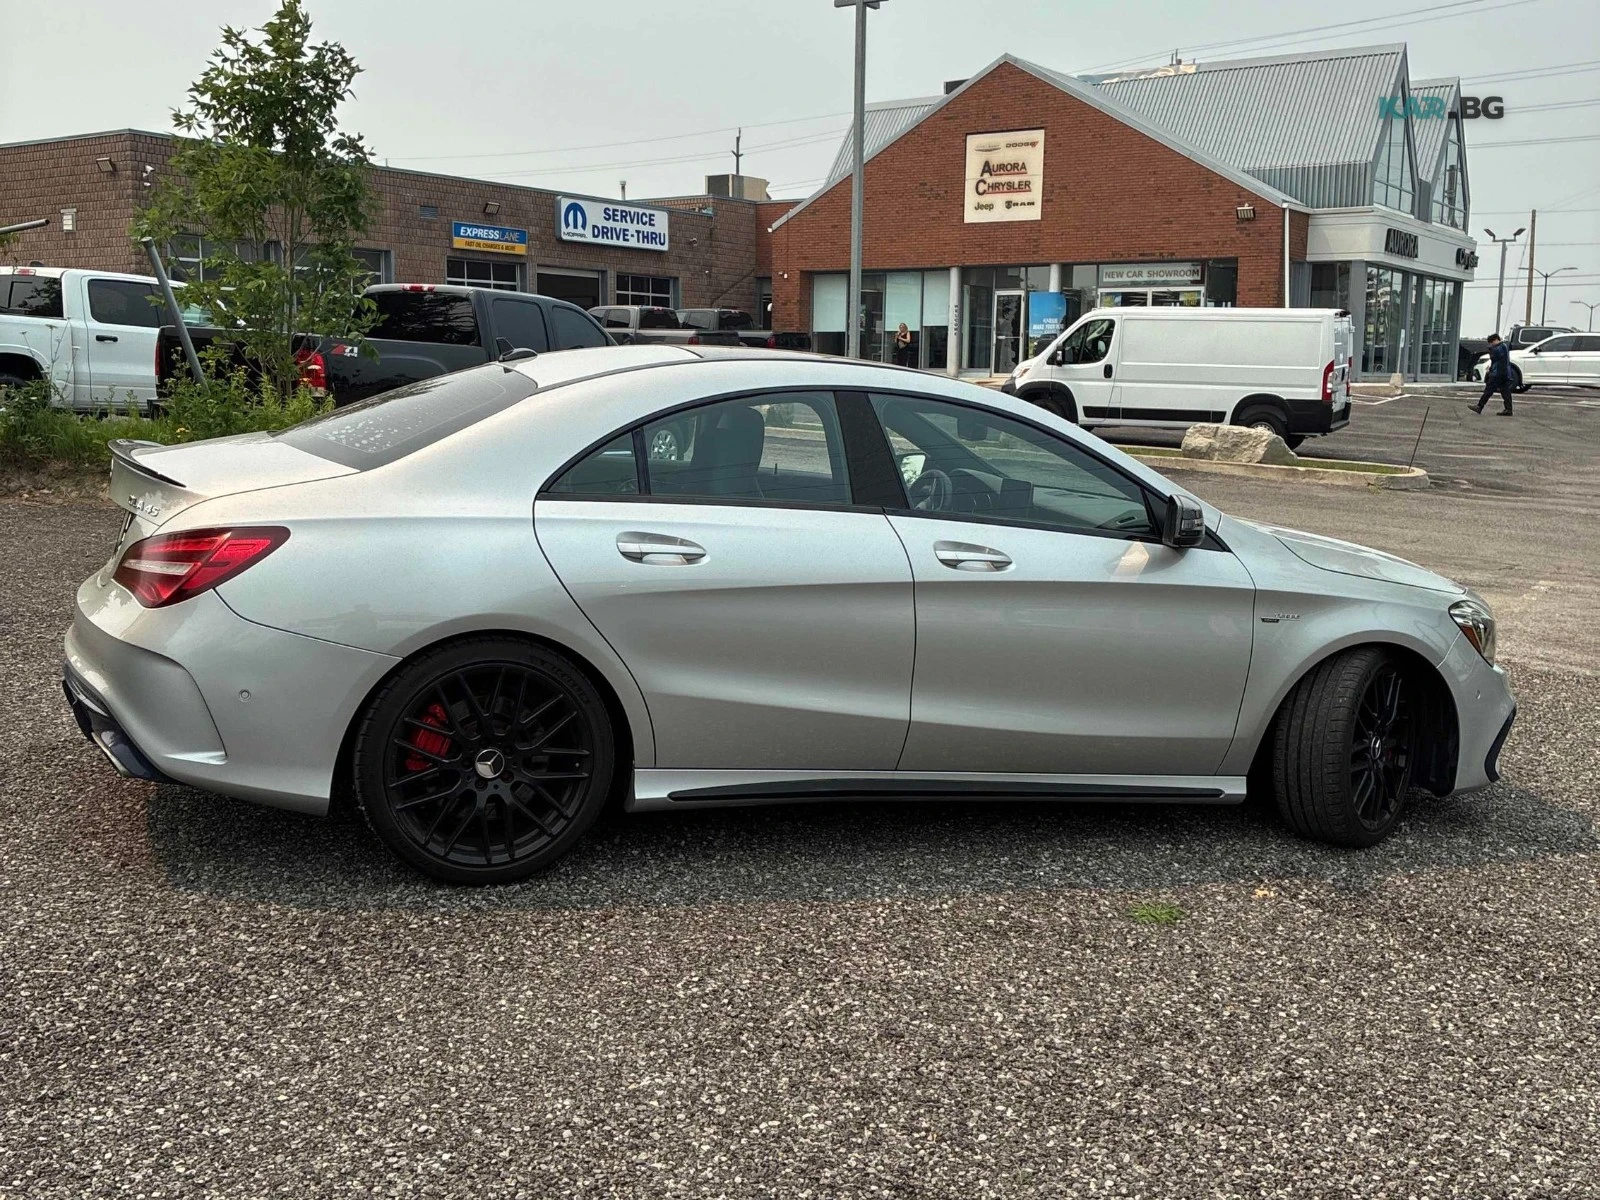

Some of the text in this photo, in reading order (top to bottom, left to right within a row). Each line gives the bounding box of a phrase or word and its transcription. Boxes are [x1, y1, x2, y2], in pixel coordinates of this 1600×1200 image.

[980, 160, 1028, 177] AURORA
[975, 179, 1032, 196] CHRYSLER
[974, 202, 994, 211] Jeep
[603, 207, 656, 227] SERVICE
[591, 224, 666, 246] DRIVE-THRU
[1384, 228, 1419, 258] AURORA
[465, 240, 475, 248] FAST
[1104, 269, 1200, 279] NEW CAR SHOWROOM
